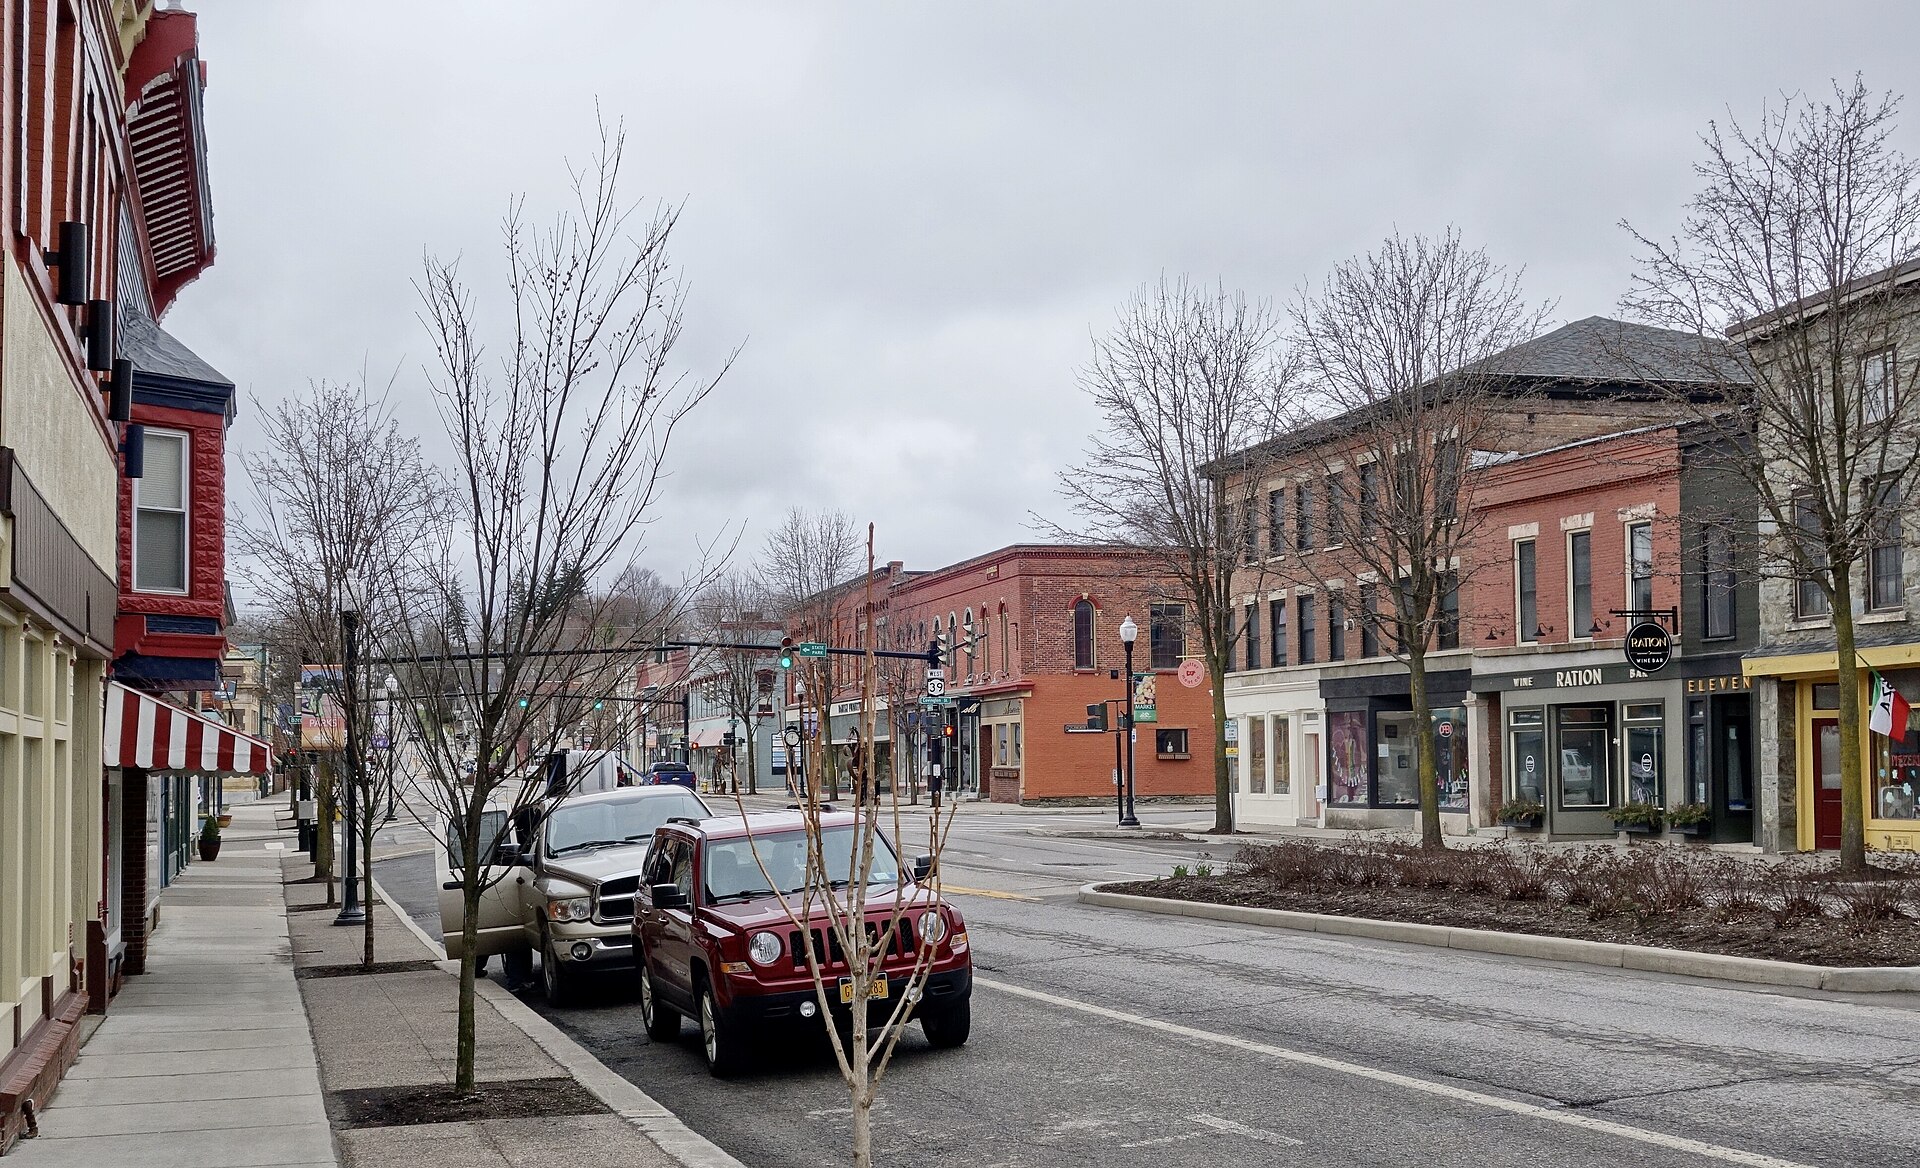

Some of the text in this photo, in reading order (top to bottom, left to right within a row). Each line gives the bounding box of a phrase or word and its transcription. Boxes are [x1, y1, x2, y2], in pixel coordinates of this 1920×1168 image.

[1631, 637, 1667, 648] RATION
[1513, 677, 1534, 687] WINE
[1556, 669, 1602, 687] RATION
[929, 682, 943, 692] 39
[1688, 676, 1753, 692] ELEVEN
[309, 719, 337, 727] PARKS
